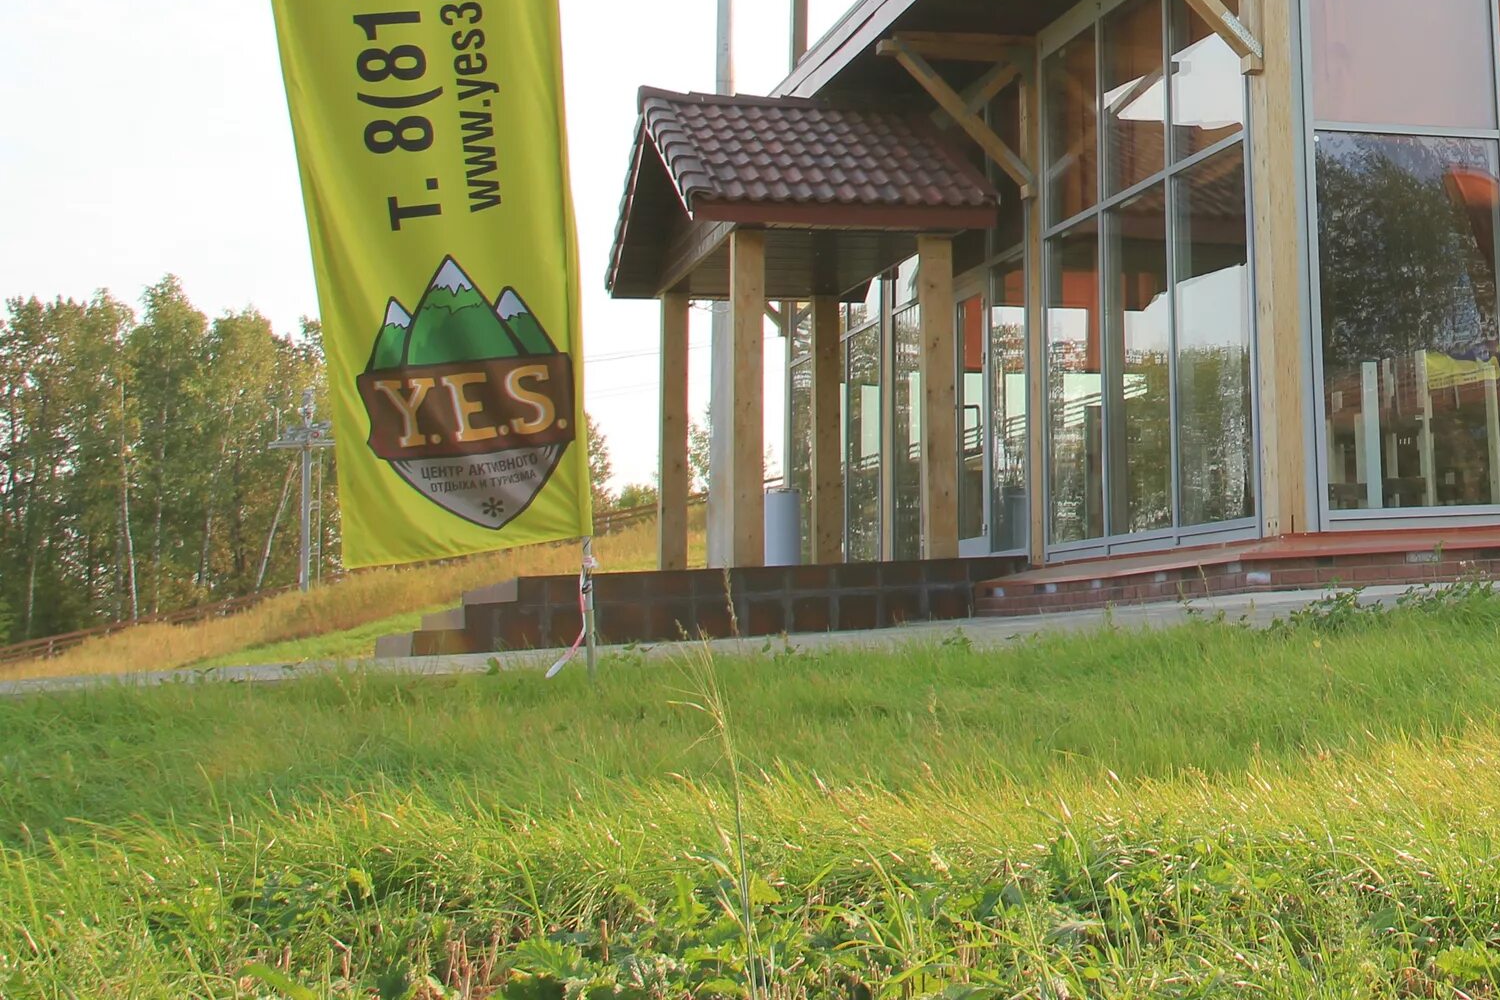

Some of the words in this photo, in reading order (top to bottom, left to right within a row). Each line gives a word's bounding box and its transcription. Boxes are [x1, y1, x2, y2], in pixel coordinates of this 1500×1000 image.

[373, 364, 568, 448] Y.E.S.
[420, 465, 464, 481] ЦЕНТР
[468, 453, 538, 476] АКТИВНОГО
[430, 480, 477, 494] ОТДЫХА
[491, 469, 537, 487] ТУРИЗМА
